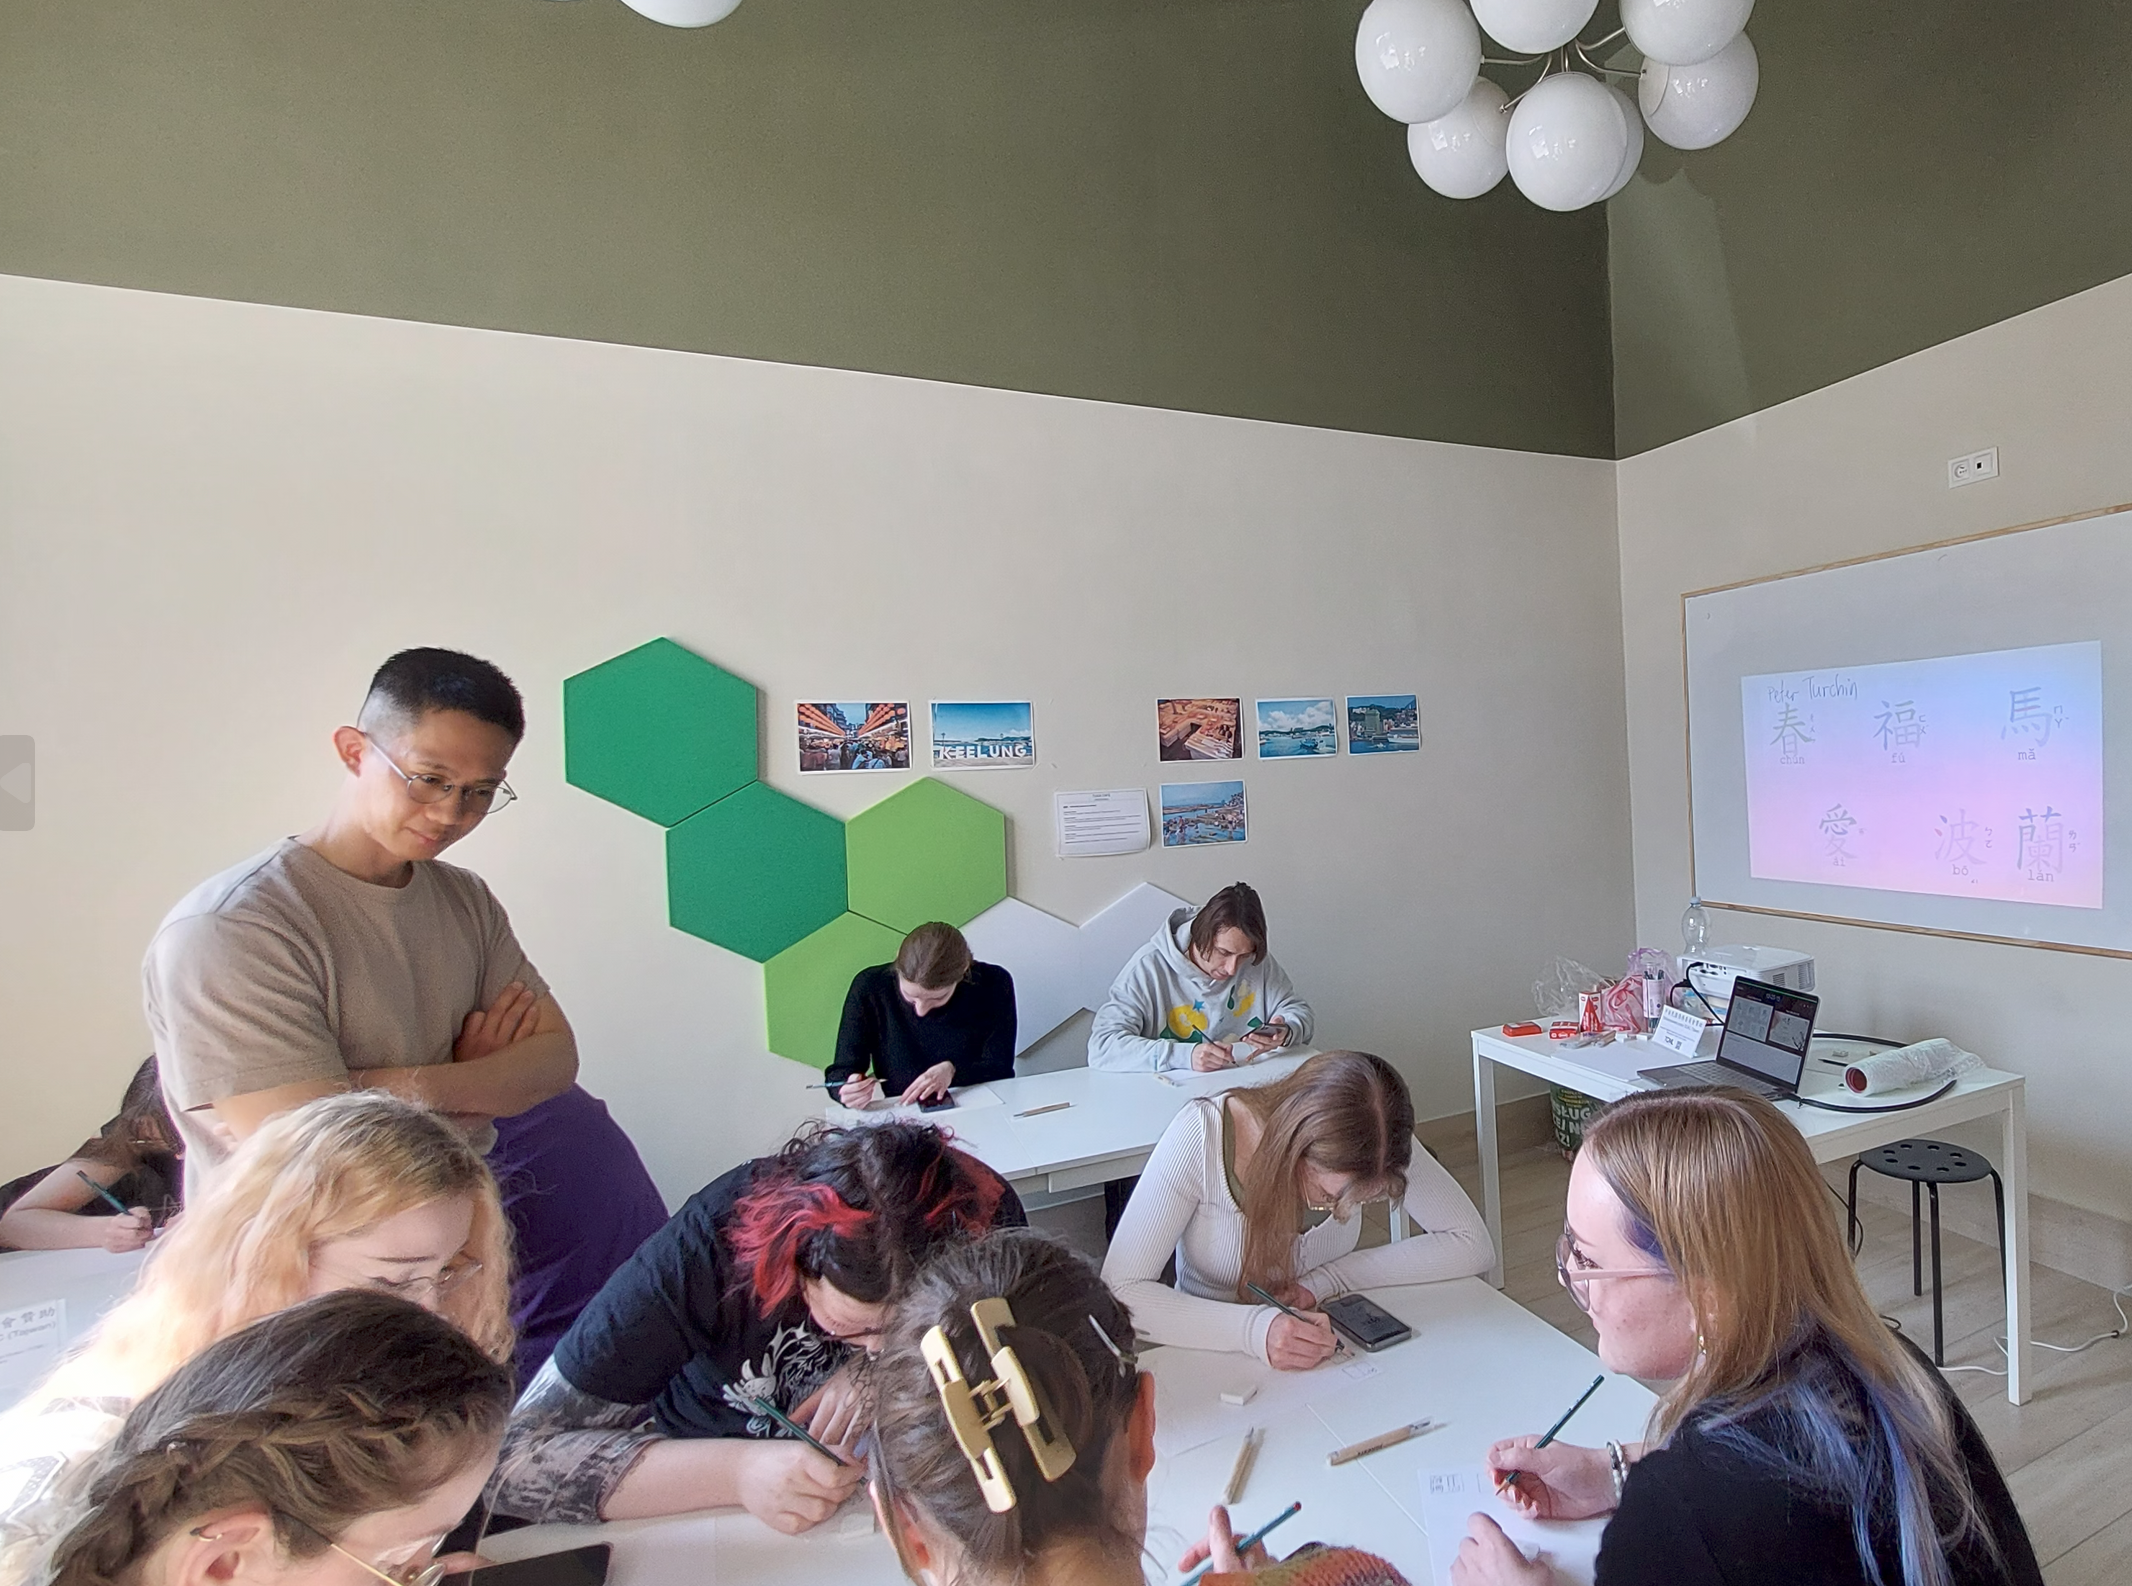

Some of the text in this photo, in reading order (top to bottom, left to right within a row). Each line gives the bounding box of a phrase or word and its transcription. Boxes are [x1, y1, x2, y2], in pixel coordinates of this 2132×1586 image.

[1767, 673, 1858, 703] Peter Turchin
[1770, 702, 1813, 756] 春
[1873, 700, 1920, 751] 福
[2001, 687, 2053, 747] 馬
[940, 744, 1027, 760] KEELUNG
[1819, 803, 1858, 859] 愛
[1934, 808, 1987, 865] 波
[2017, 806, 2064, 874] 蘭
